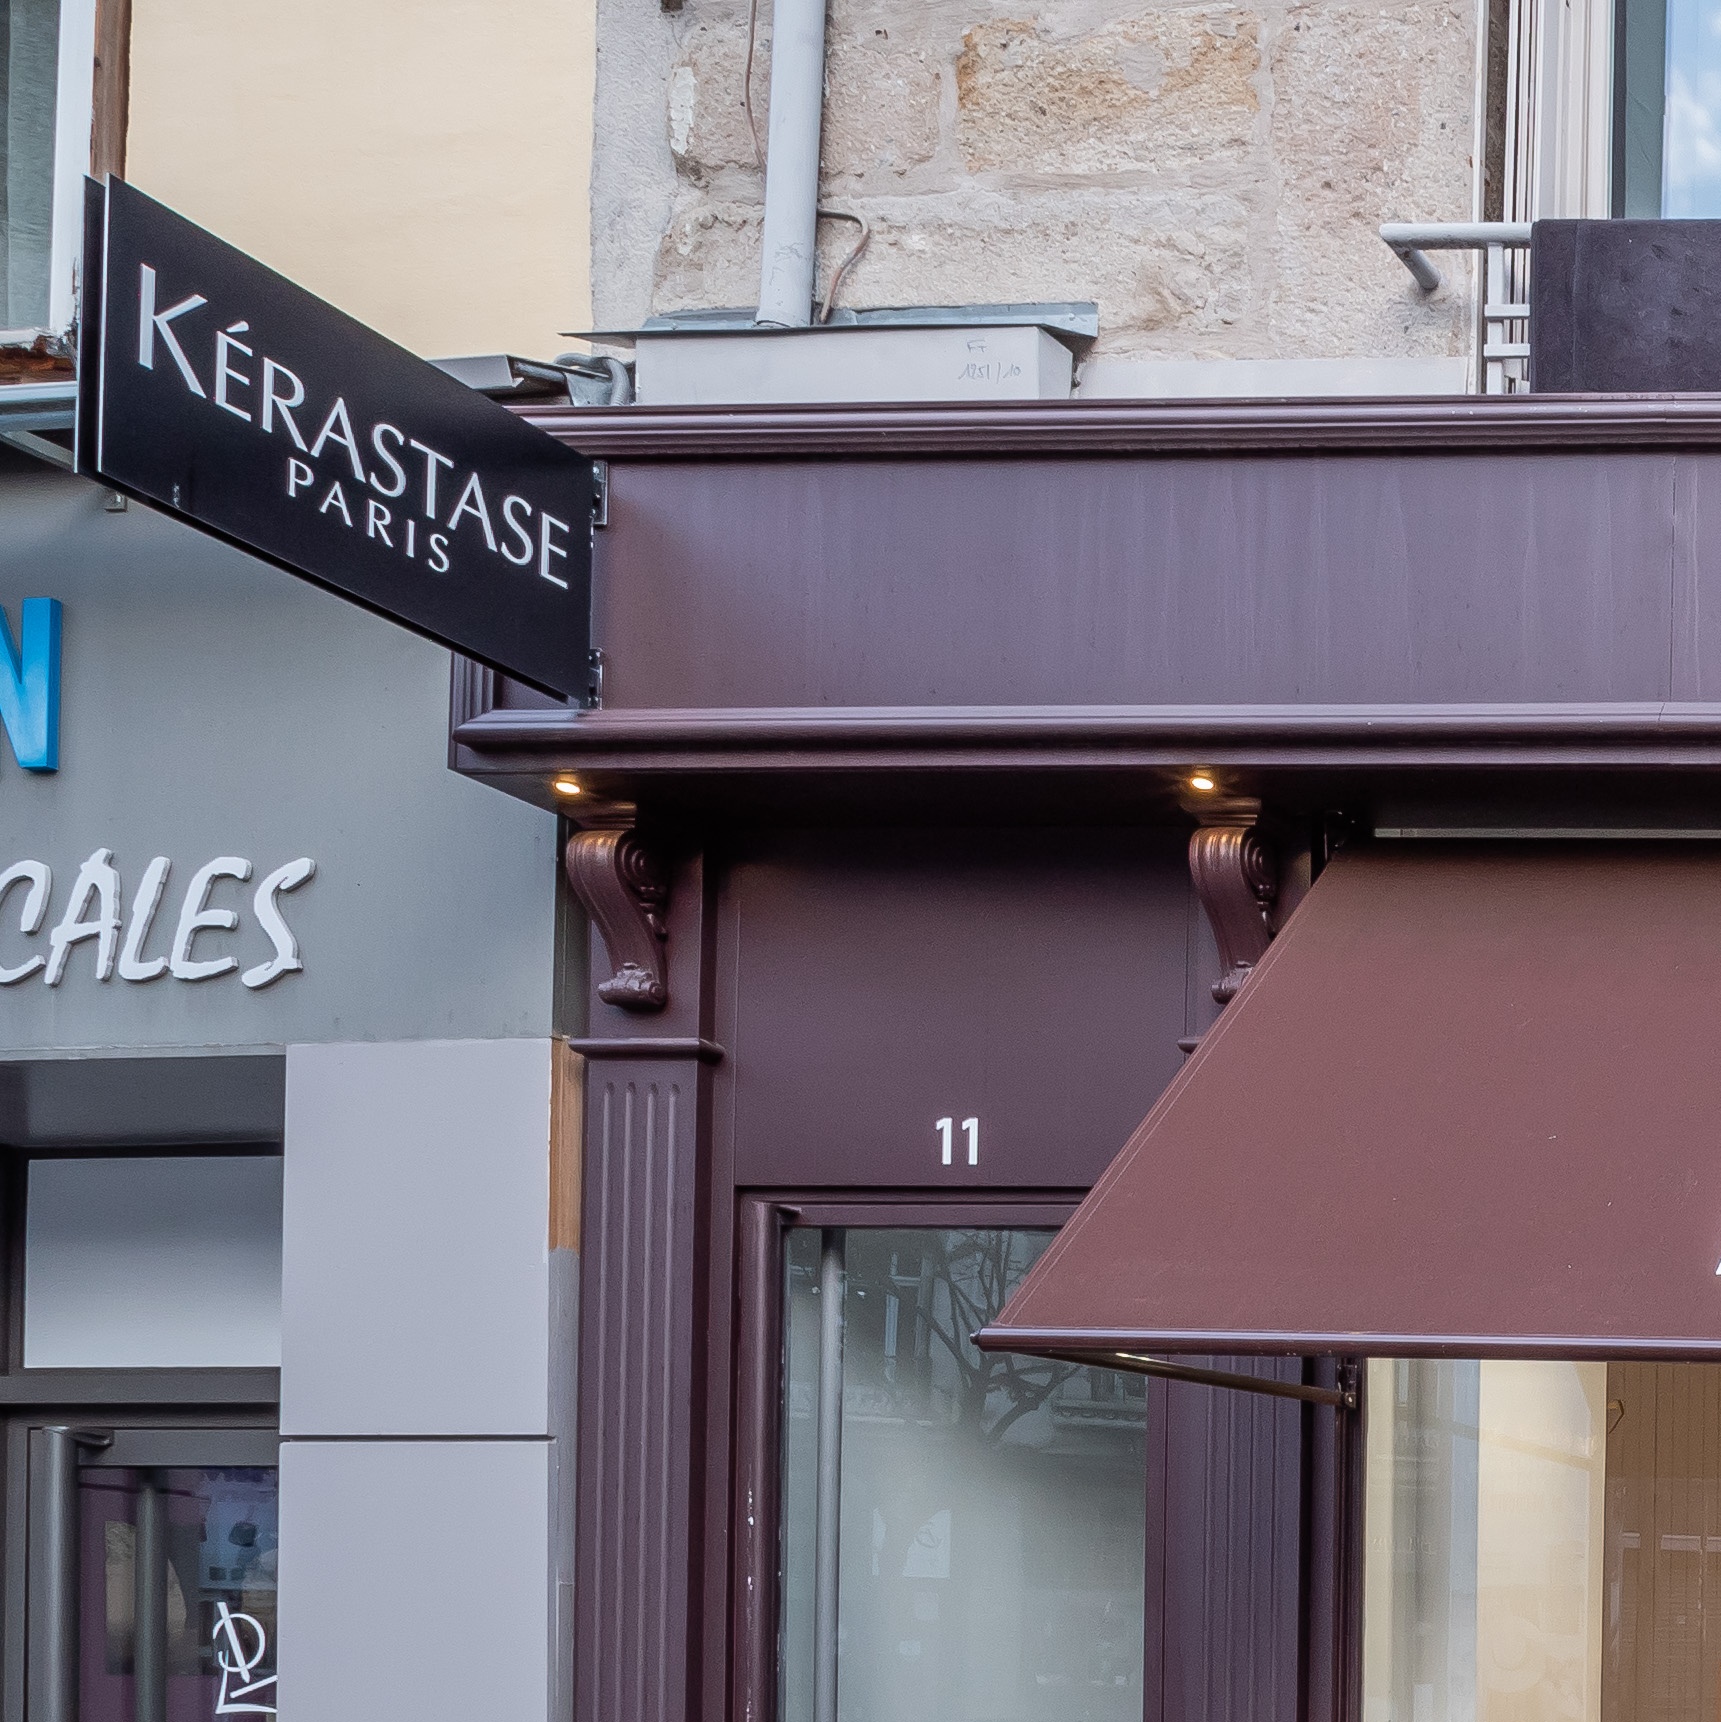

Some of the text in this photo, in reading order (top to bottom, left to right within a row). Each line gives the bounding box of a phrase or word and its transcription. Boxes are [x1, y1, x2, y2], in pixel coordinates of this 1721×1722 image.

[138, 261, 571, 591] KÉRASTASE
[288, 455, 452, 574] PARIS
[935, 1116, 979, 1166] 11
